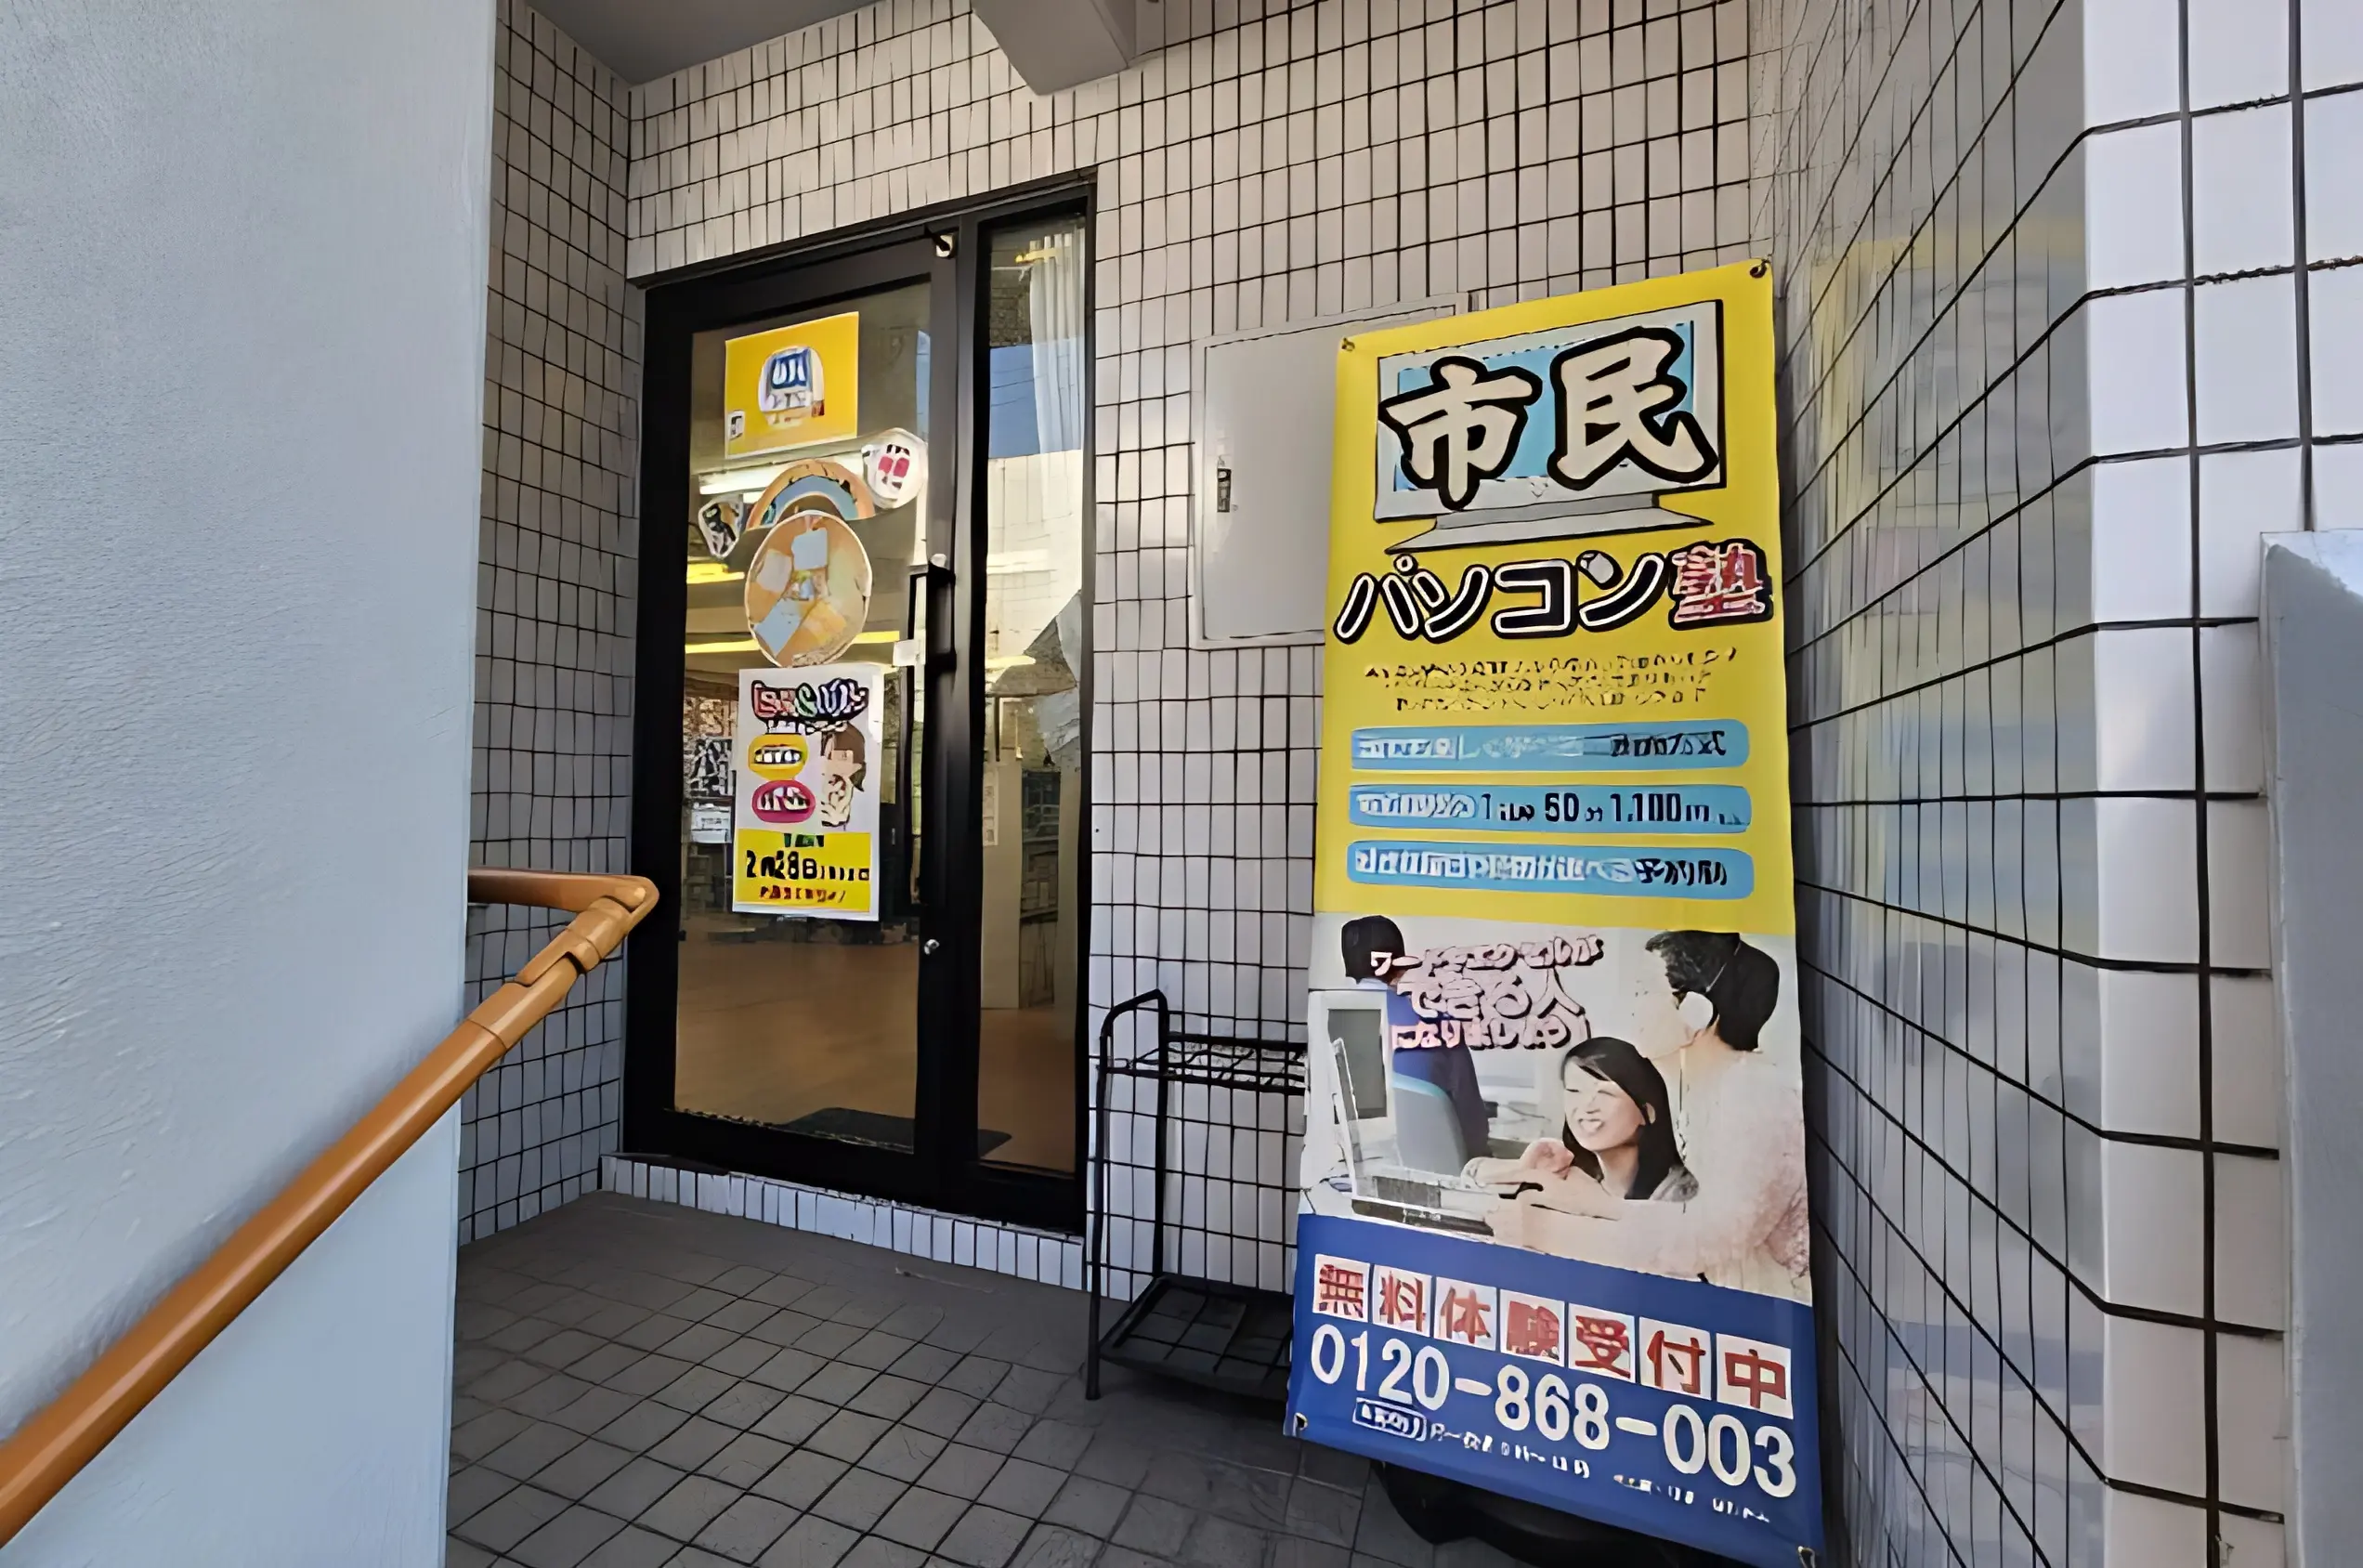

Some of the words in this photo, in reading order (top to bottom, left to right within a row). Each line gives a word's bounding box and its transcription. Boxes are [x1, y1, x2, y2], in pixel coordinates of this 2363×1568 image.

[1378, 326, 1720, 510] 市民
[1333, 539, 1773, 641] パソコン塾
[1311, 1323, 1797, 1498] 0120-868-003
[1317, 1261, 1788, 1409] 無料体験受付中
